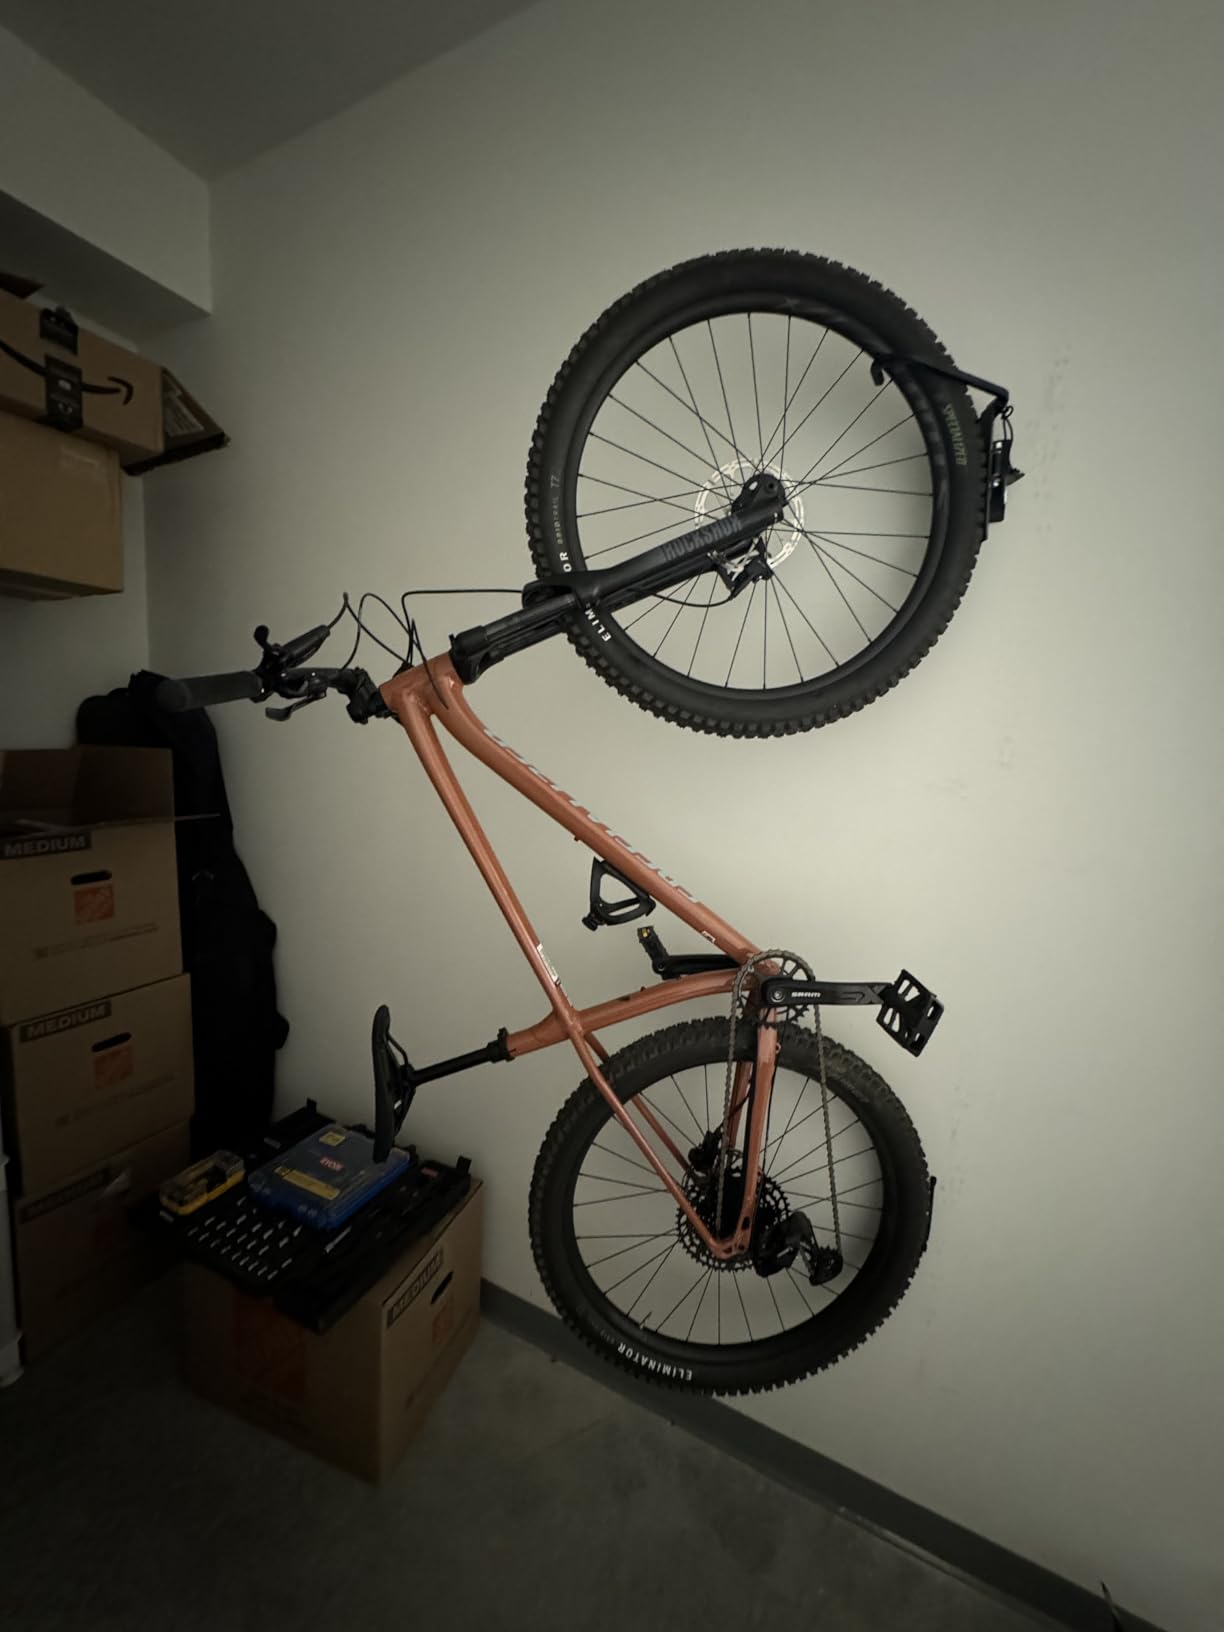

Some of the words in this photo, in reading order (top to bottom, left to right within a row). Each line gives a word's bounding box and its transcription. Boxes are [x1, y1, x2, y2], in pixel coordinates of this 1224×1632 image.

[663, 516, 742, 561] ROCKSHOX
[4, 834, 86, 857] MEDIUM
[29, 1003, 107, 1037] MEDIUM
[617, 1342, 693, 1382] ELIMINATOR
